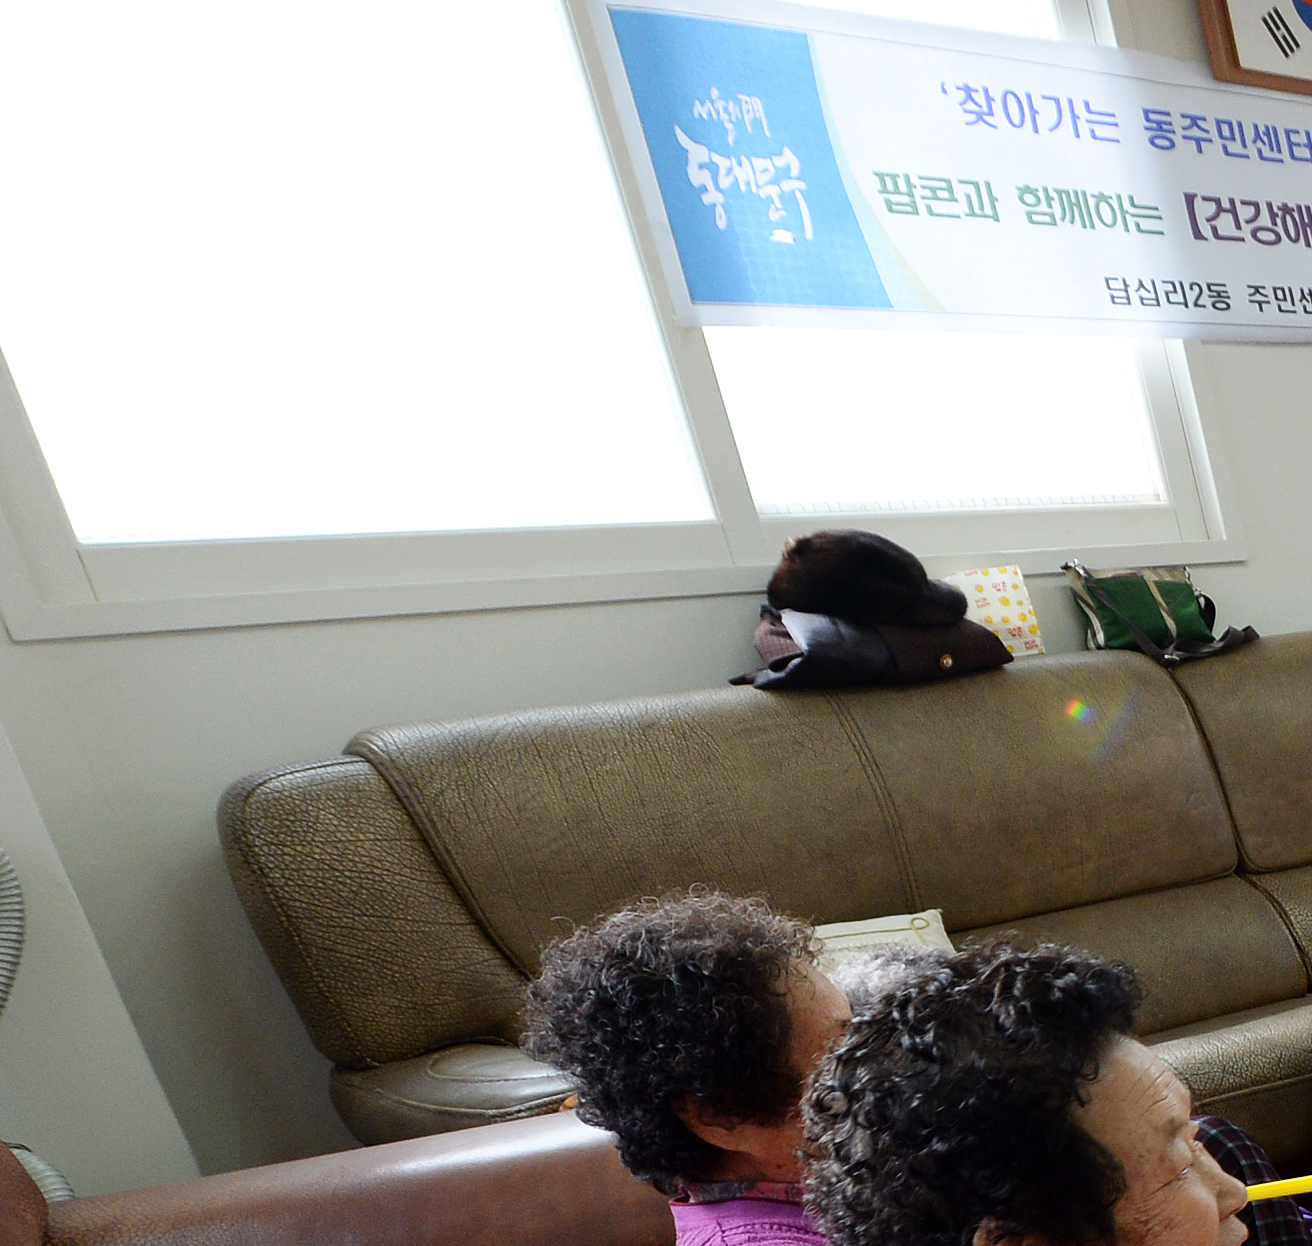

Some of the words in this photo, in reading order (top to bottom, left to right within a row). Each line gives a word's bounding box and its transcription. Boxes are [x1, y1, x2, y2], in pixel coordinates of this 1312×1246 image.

[872, 170, 1000, 223] 팝콘과
[1015, 184, 1165, 236] 함께하는
[1103, 276, 1232, 312] 답십리2동
